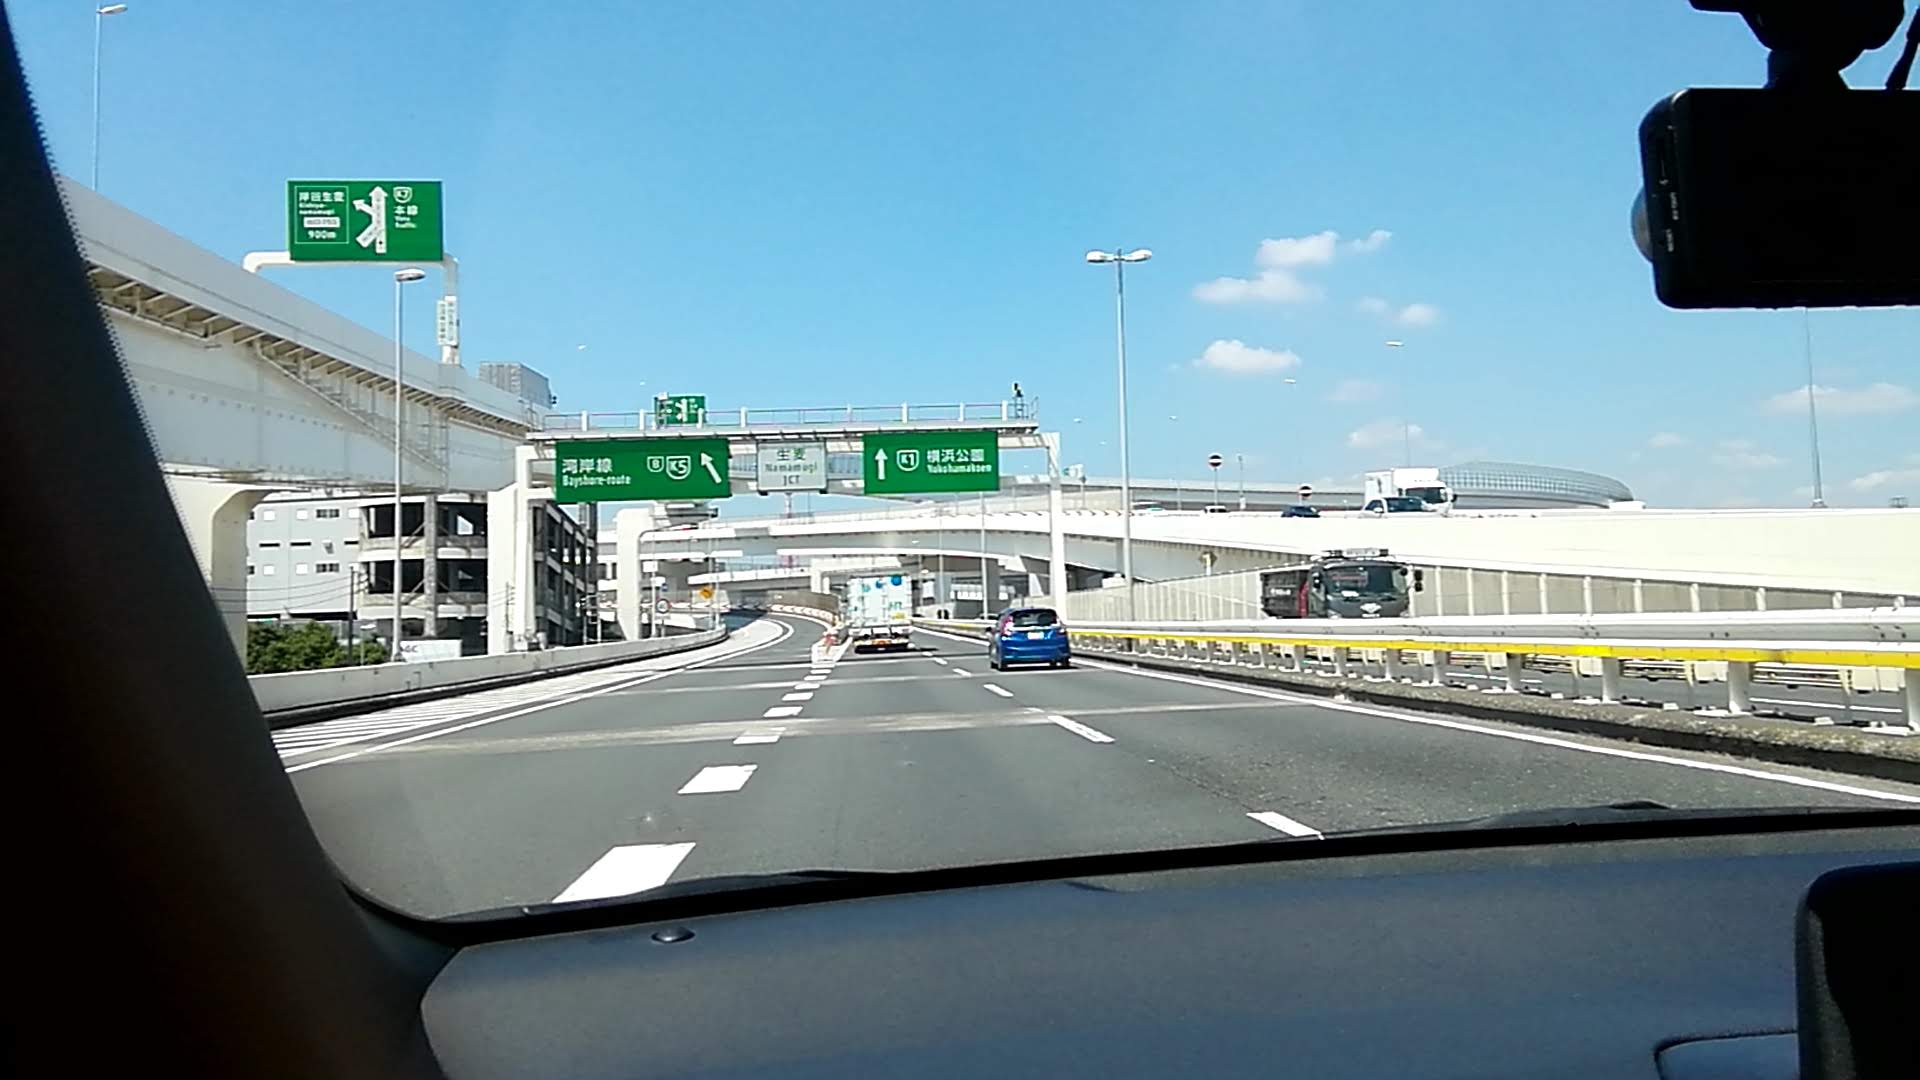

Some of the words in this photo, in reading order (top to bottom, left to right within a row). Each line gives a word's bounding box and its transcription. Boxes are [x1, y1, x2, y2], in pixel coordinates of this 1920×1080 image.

[308, 231, 336, 239] 900m
[777, 448, 807, 461] 生麦
[927, 448, 985, 463] 横浜公園
[562, 459, 612, 474] 湾岸線
[765, 462, 818, 475] Namamugi
[927, 463, 993, 474] Yokohamakoen
[562, 475, 631, 488] Bayshore-route
[783, 474, 800, 487] JCT
